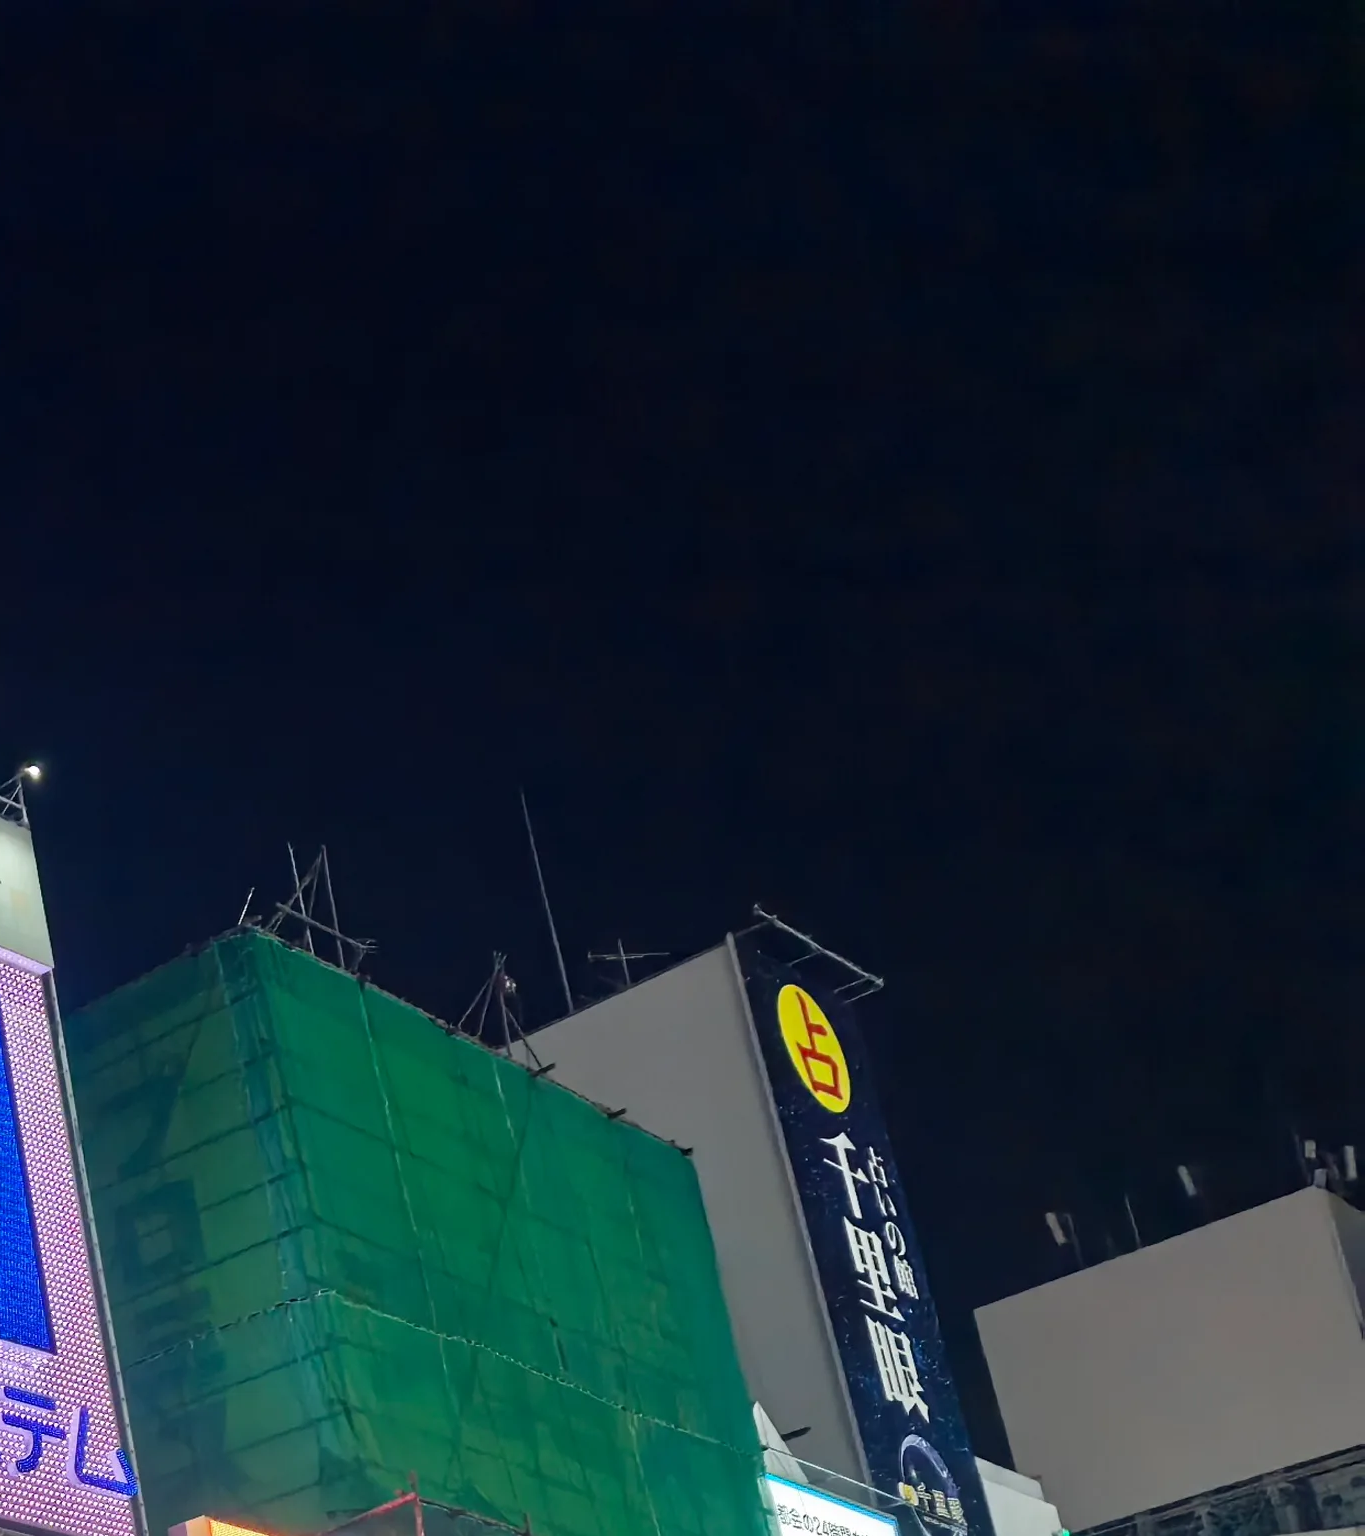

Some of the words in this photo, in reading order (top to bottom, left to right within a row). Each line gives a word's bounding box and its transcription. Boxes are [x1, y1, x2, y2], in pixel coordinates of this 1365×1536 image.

[795, 989, 844, 1101] 占
[819, 1131, 930, 1425] 千里眼
